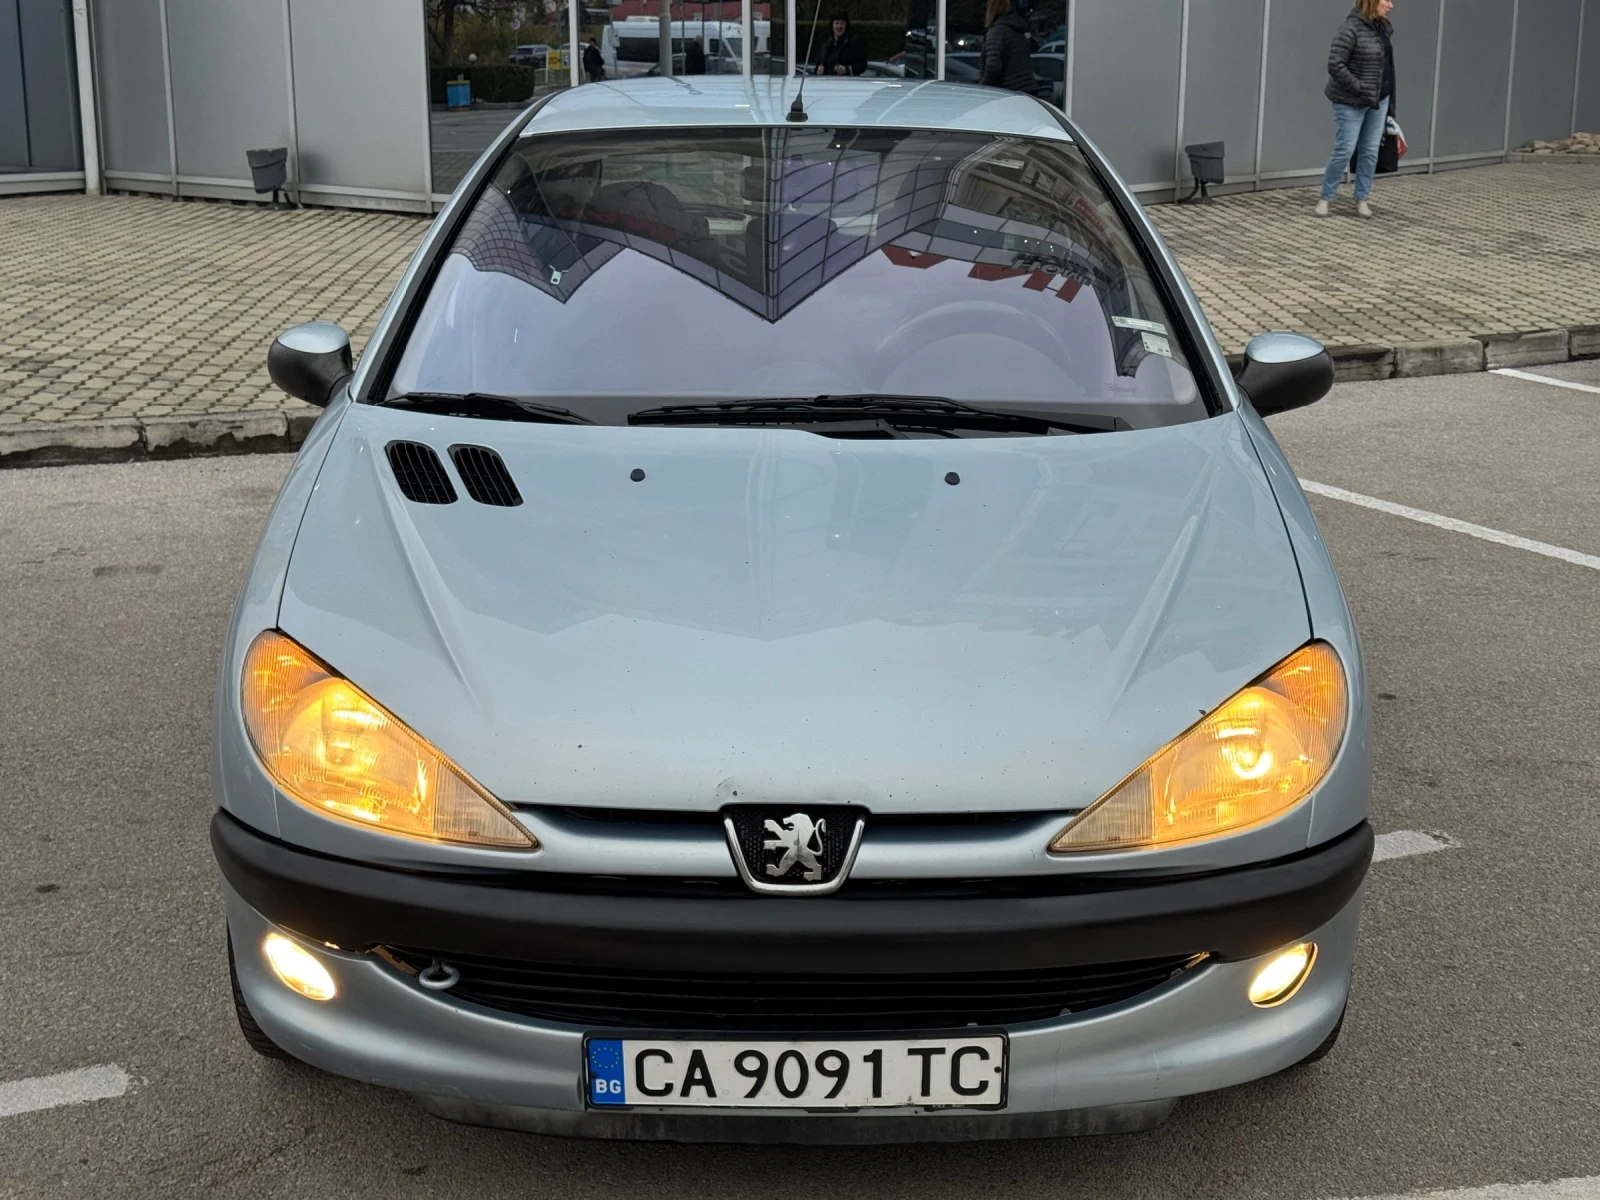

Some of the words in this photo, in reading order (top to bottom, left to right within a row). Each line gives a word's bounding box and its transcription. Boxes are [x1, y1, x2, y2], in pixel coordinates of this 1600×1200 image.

[595, 1078, 622, 1095] BG
[635, 1048, 717, 1098] CA
[734, 1048, 883, 1099] 9091
[907, 1045, 990, 1097] TC
